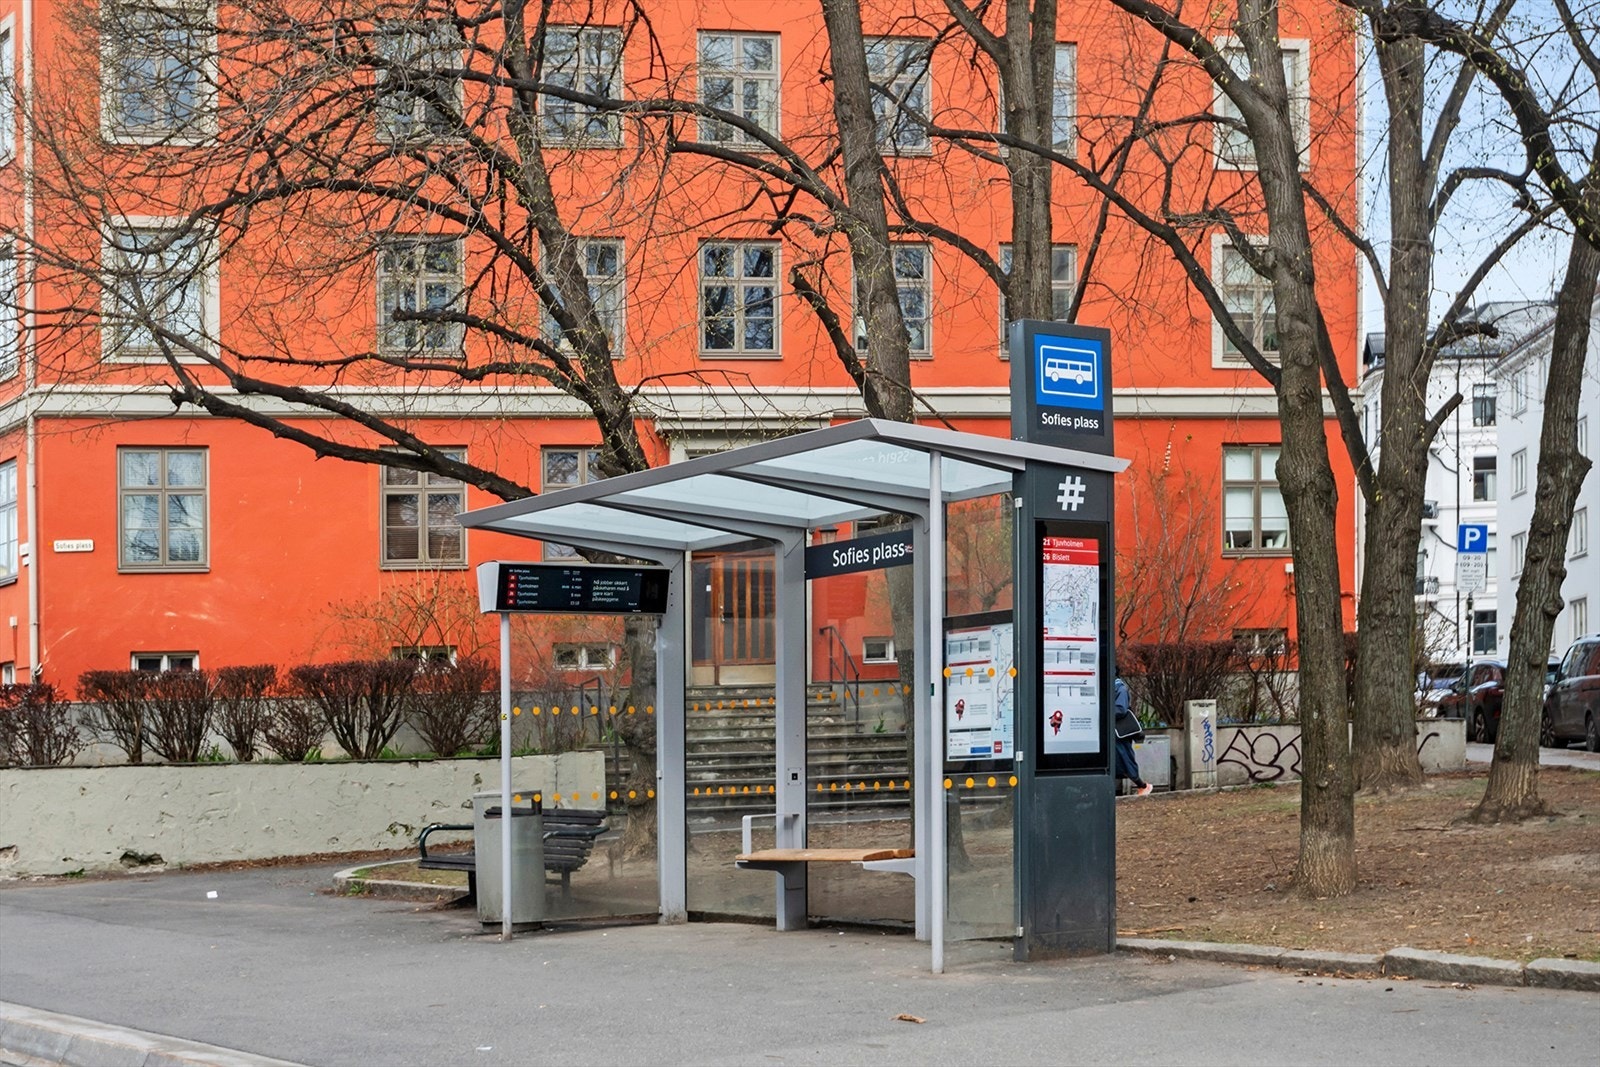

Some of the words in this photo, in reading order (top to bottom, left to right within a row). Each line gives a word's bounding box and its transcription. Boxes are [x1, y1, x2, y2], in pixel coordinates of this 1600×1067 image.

[1041, 412, 1072, 426] Sofies
[1074, 416, 1099, 429] plass
[1043, 538, 1050, 546] 21
[1052, 538, 1084, 548] Tjuvholmen
[1464, 527, 1481, 550] P
[76, 542, 92, 550] plass
[832, 547, 869, 567] Sofies
[873, 542, 905, 565] plass
[1052, 553, 1070, 561] Bislett
